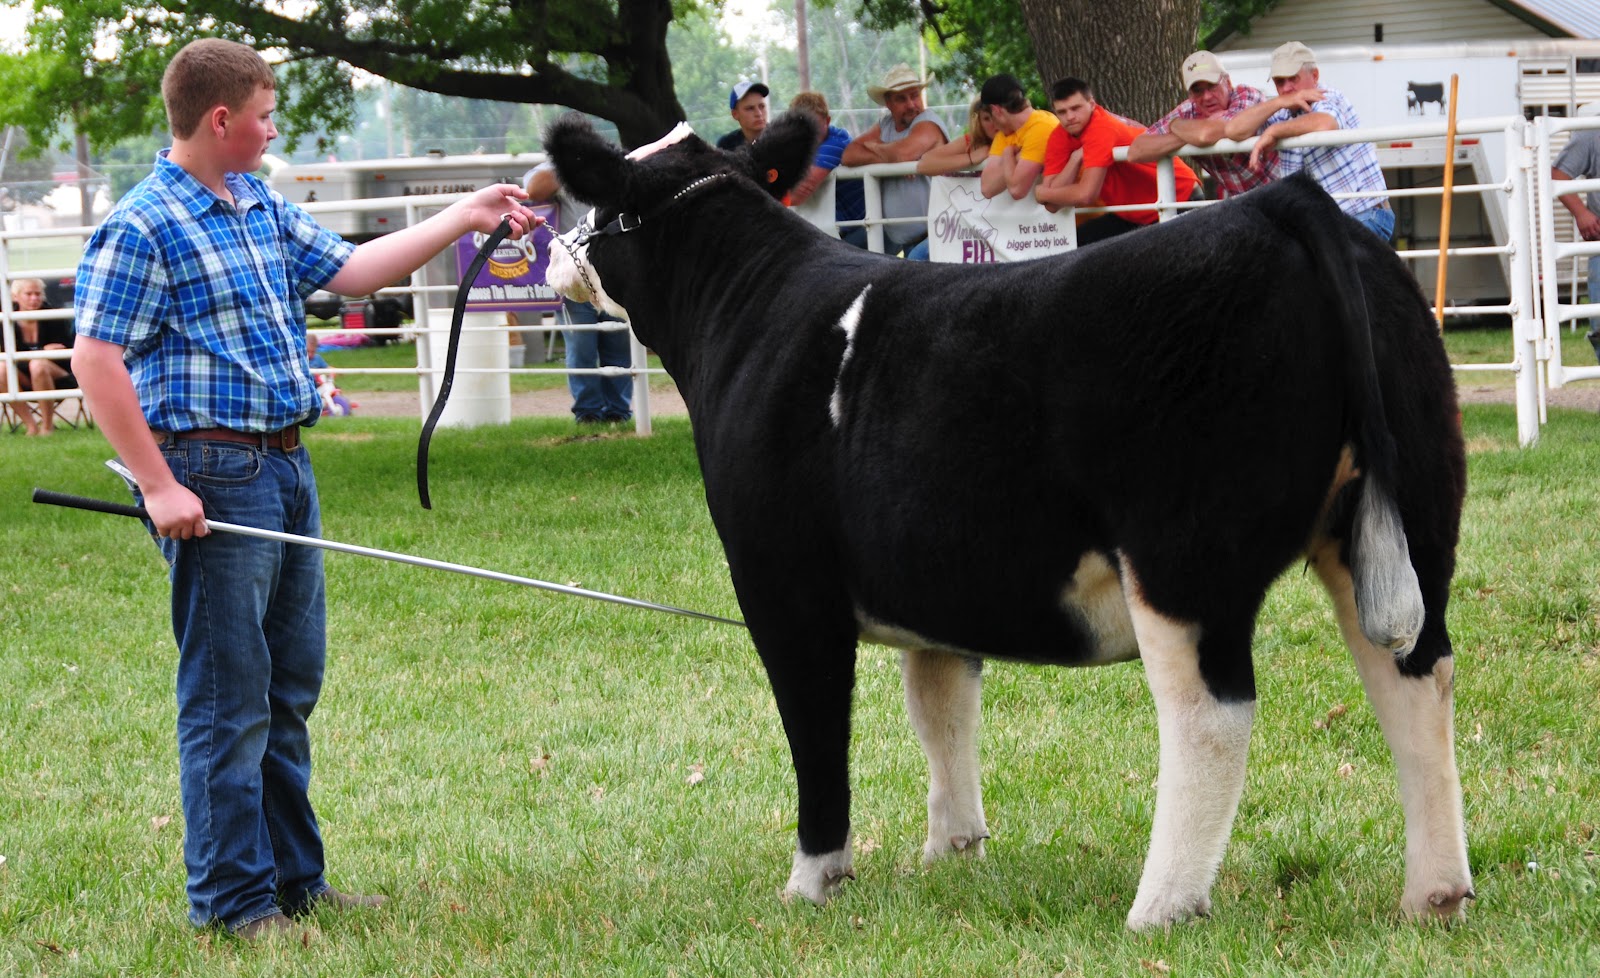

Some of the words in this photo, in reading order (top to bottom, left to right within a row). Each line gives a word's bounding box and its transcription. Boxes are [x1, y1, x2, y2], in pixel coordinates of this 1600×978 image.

[1018, 223, 1031, 235] For
[1033, 225, 1037, 234] a
[1038, 221, 1058, 234] fuller,
[1005, 238, 1032, 252] bigger
[1034, 237, 1051, 250] body
[1053, 235, 1069, 247] look.
[490, 284, 505, 300] The
